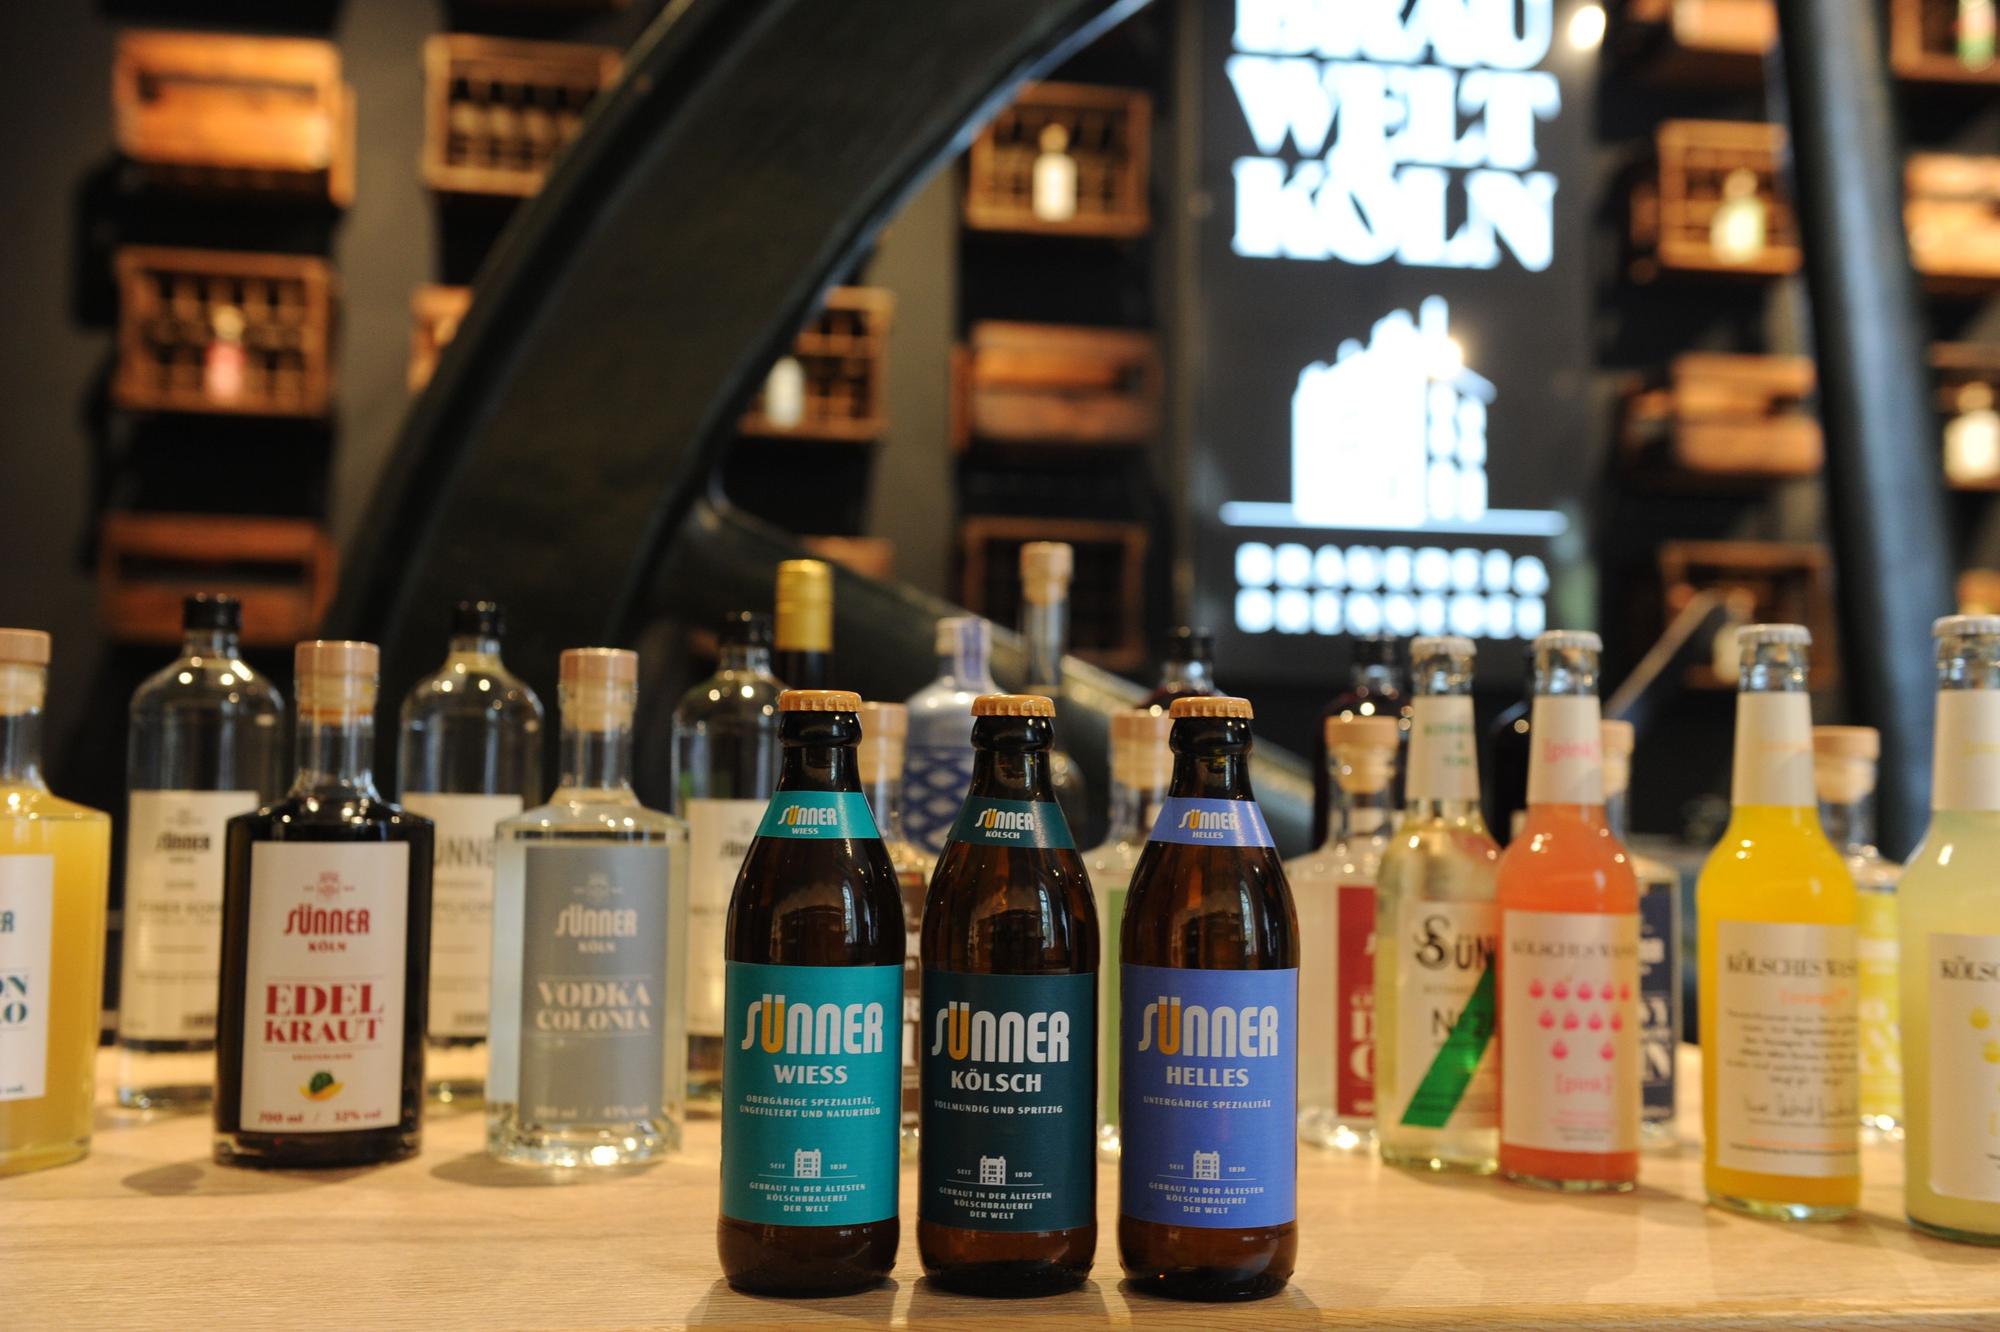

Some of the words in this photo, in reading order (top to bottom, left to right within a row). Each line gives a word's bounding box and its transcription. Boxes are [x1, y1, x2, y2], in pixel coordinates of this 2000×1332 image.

[778, 805, 838, 826] SÜNNER
[975, 808, 1035, 831] SÜNNER
[1178, 809, 1238, 830] SÜNNER
[792, 827, 819, 835] WIESS
[985, 830, 1020, 839] KÖLSCH
[1192, 831, 1224, 839] HELLES
[284, 903, 371, 935] SÜNNER
[555, 904, 638, 938] SÜNNER
[308, 940, 347, 953] KÖLN
[265, 983, 385, 1017] EDEL
[537, 980, 652, 1008] VODKA
[535, 1008, 651, 1032] COLONIA
[741, 993, 884, 1055] SÜNNER
[1138, 995, 1279, 1058] SÜNNER
[263, 1017, 385, 1044] KRAUT
[931, 1001, 1070, 1063] SÜNNER
[773, 1064, 848, 1085] WIESS
[951, 1068, 1042, 1093] KÖLSCH
[1166, 1065, 1249, 1087] HELLES
[746, 1094, 807, 1106] OBERGÄRIGE
[1143, 1096, 1209, 1109] UNTERGÄRIGE
[1212, 1098, 1272, 1109] SPEZIALITÄT
[740, 1105, 798, 1117] UNGEFILTERT
[801, 1109, 823, 1118] UND
[934, 1100, 990, 1114] VOLLMUNDIG
[992, 1105, 1015, 1114] UND
[1017, 1105, 1063, 1115] SPRITZIG
[769, 1162, 786, 1170] SEIT
[956, 1168, 972, 1176] SEIT
[1168, 1163, 1185, 1171] SEIT
[749, 1181, 787, 1192] GEBRAUT
[790, 1184, 800, 1192] IN
[803, 1184, 822, 1193] DER
[825, 1183, 866, 1193] ÄLTESTEN
[939, 1186, 973, 1198] GEBRAUT
[976, 1191, 985, 1199] IN
[988, 1192, 1007, 1200] DER
[1010, 1191, 1052, 1200] ÄLTESTEN
[1148, 1182, 1187, 1193] GEBRAUT
[1224, 1186, 1265, 1194] ÄLTESTEN
[766, 1193, 848, 1203] KÖLSCHBRAUEREI
[953, 1199, 1033, 1210] KÖLSCHBRAUEREI
[1165, 1193, 1247, 1204] KÖLSCHBRAUEREI
[783, 1204, 800, 1212] DER
[970, 1210, 987, 1219] DER
[990, 1211, 1015, 1219] WELT
[1183, 1205, 1201, 1213] DER
[1204, 1206, 1229, 1214] WELT
